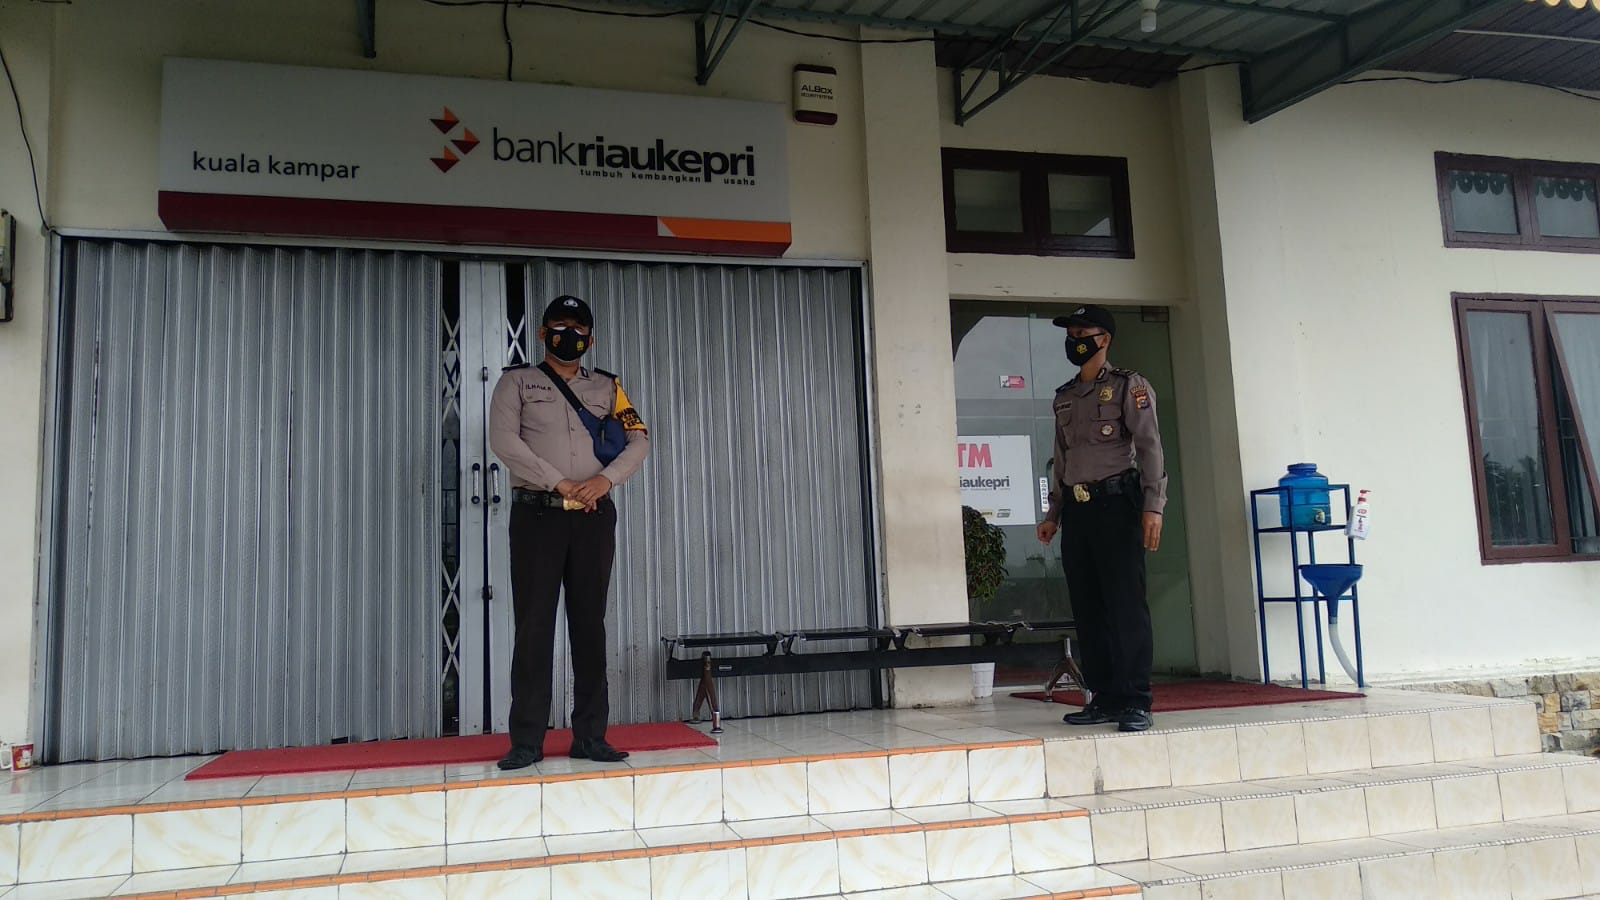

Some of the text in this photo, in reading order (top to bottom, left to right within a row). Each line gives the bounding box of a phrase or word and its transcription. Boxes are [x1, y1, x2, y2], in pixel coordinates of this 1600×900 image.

[193, 150, 360, 182] kuala kampar
[492, 127, 755, 183] bankriaukepri
[580, 168, 756, 186] tumbuh kembangkan usaha
